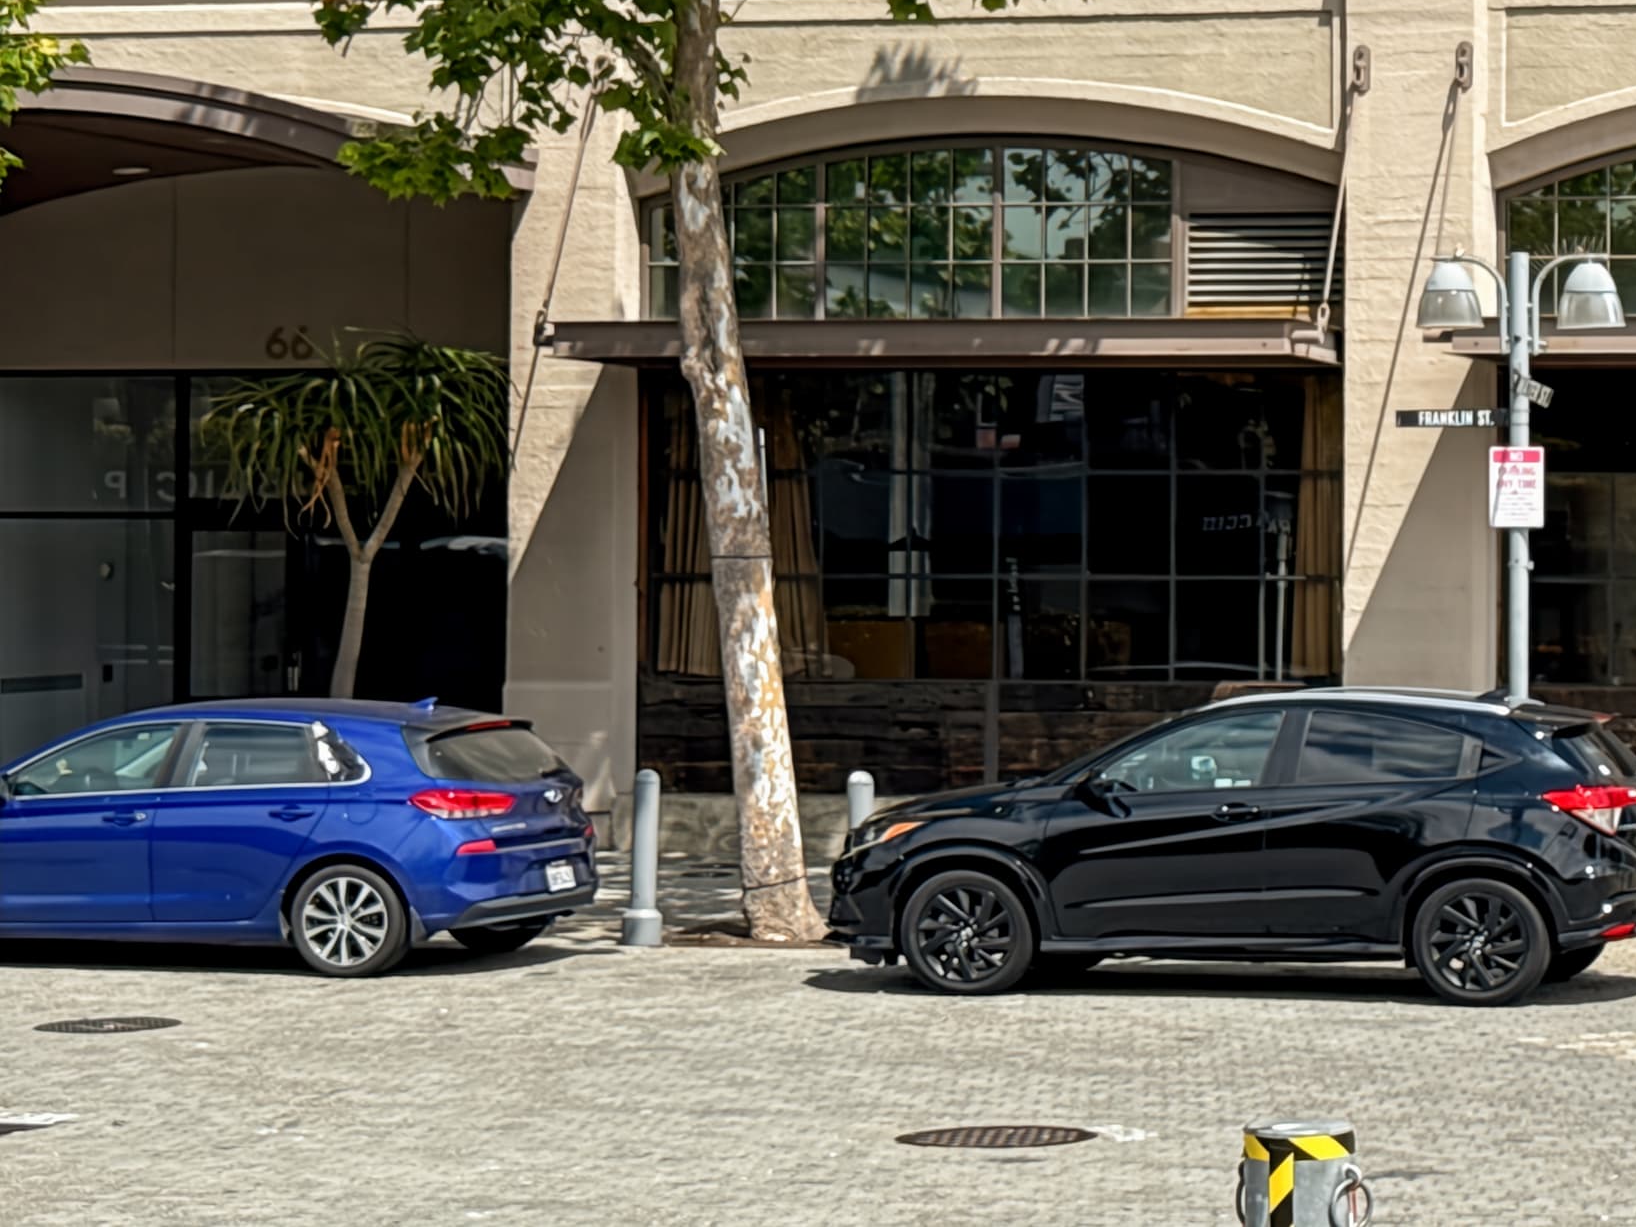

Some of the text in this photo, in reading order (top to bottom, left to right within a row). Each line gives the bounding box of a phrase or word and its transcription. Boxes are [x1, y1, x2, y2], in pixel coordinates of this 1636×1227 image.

[265, 325, 314, 360] 66
[1418, 410, 1496, 426] FRANKLIN ST.
